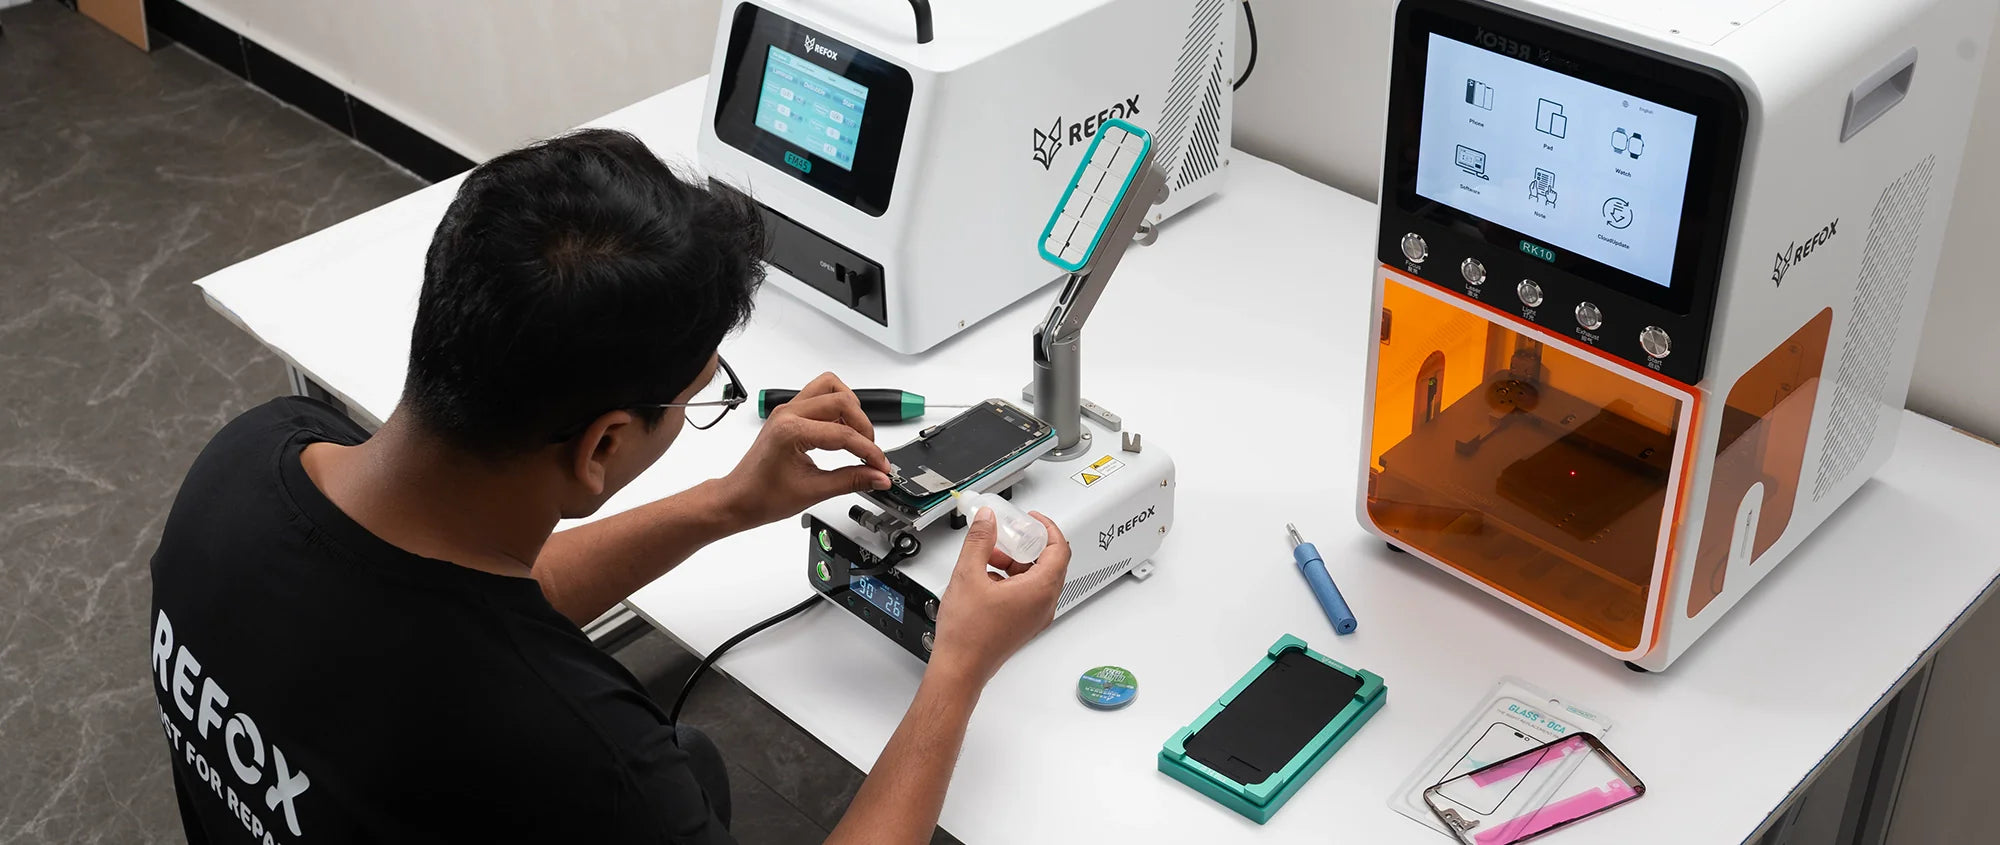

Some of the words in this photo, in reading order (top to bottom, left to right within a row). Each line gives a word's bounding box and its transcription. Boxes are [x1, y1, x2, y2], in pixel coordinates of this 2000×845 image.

[814, 44, 838, 61] REFOX
[1639, 106, 1653, 115] English
[1069, 94, 1140, 146] REFOX
[1468, 118, 1485, 128] Phone
[1543, 143, 1553, 152] Pad
[1615, 168, 1632, 178] Watch
[1460, 183, 1481, 195] Software
[1534, 211, 1546, 220] Note
[1597, 233, 1630, 250] CloudUpdate
[1793, 217, 1839, 266] REFOX
[1522, 242, 1552, 261] RK10
[820, 260, 835, 273] OPEN
[1405, 259, 1422, 270] Focus
[1465, 283, 1482, 294] Laser
[1522, 306, 1537, 317] Light
[1575, 326, 1600, 341] Exhaust
[1647, 355, 1662, 366] Start
[1117, 505, 1155, 537] REFOX
[859, 578, 875, 600] 90
[885, 595, 901, 618] 26
[153, 608, 311, 837] REFOX
[1508, 704, 1539, 722] GLASS
[1546, 721, 1567, 734] OCA
[157, 697, 182, 751] ST
[186, 741, 223, 800] FOR
[227, 786, 281, 845] REPA
